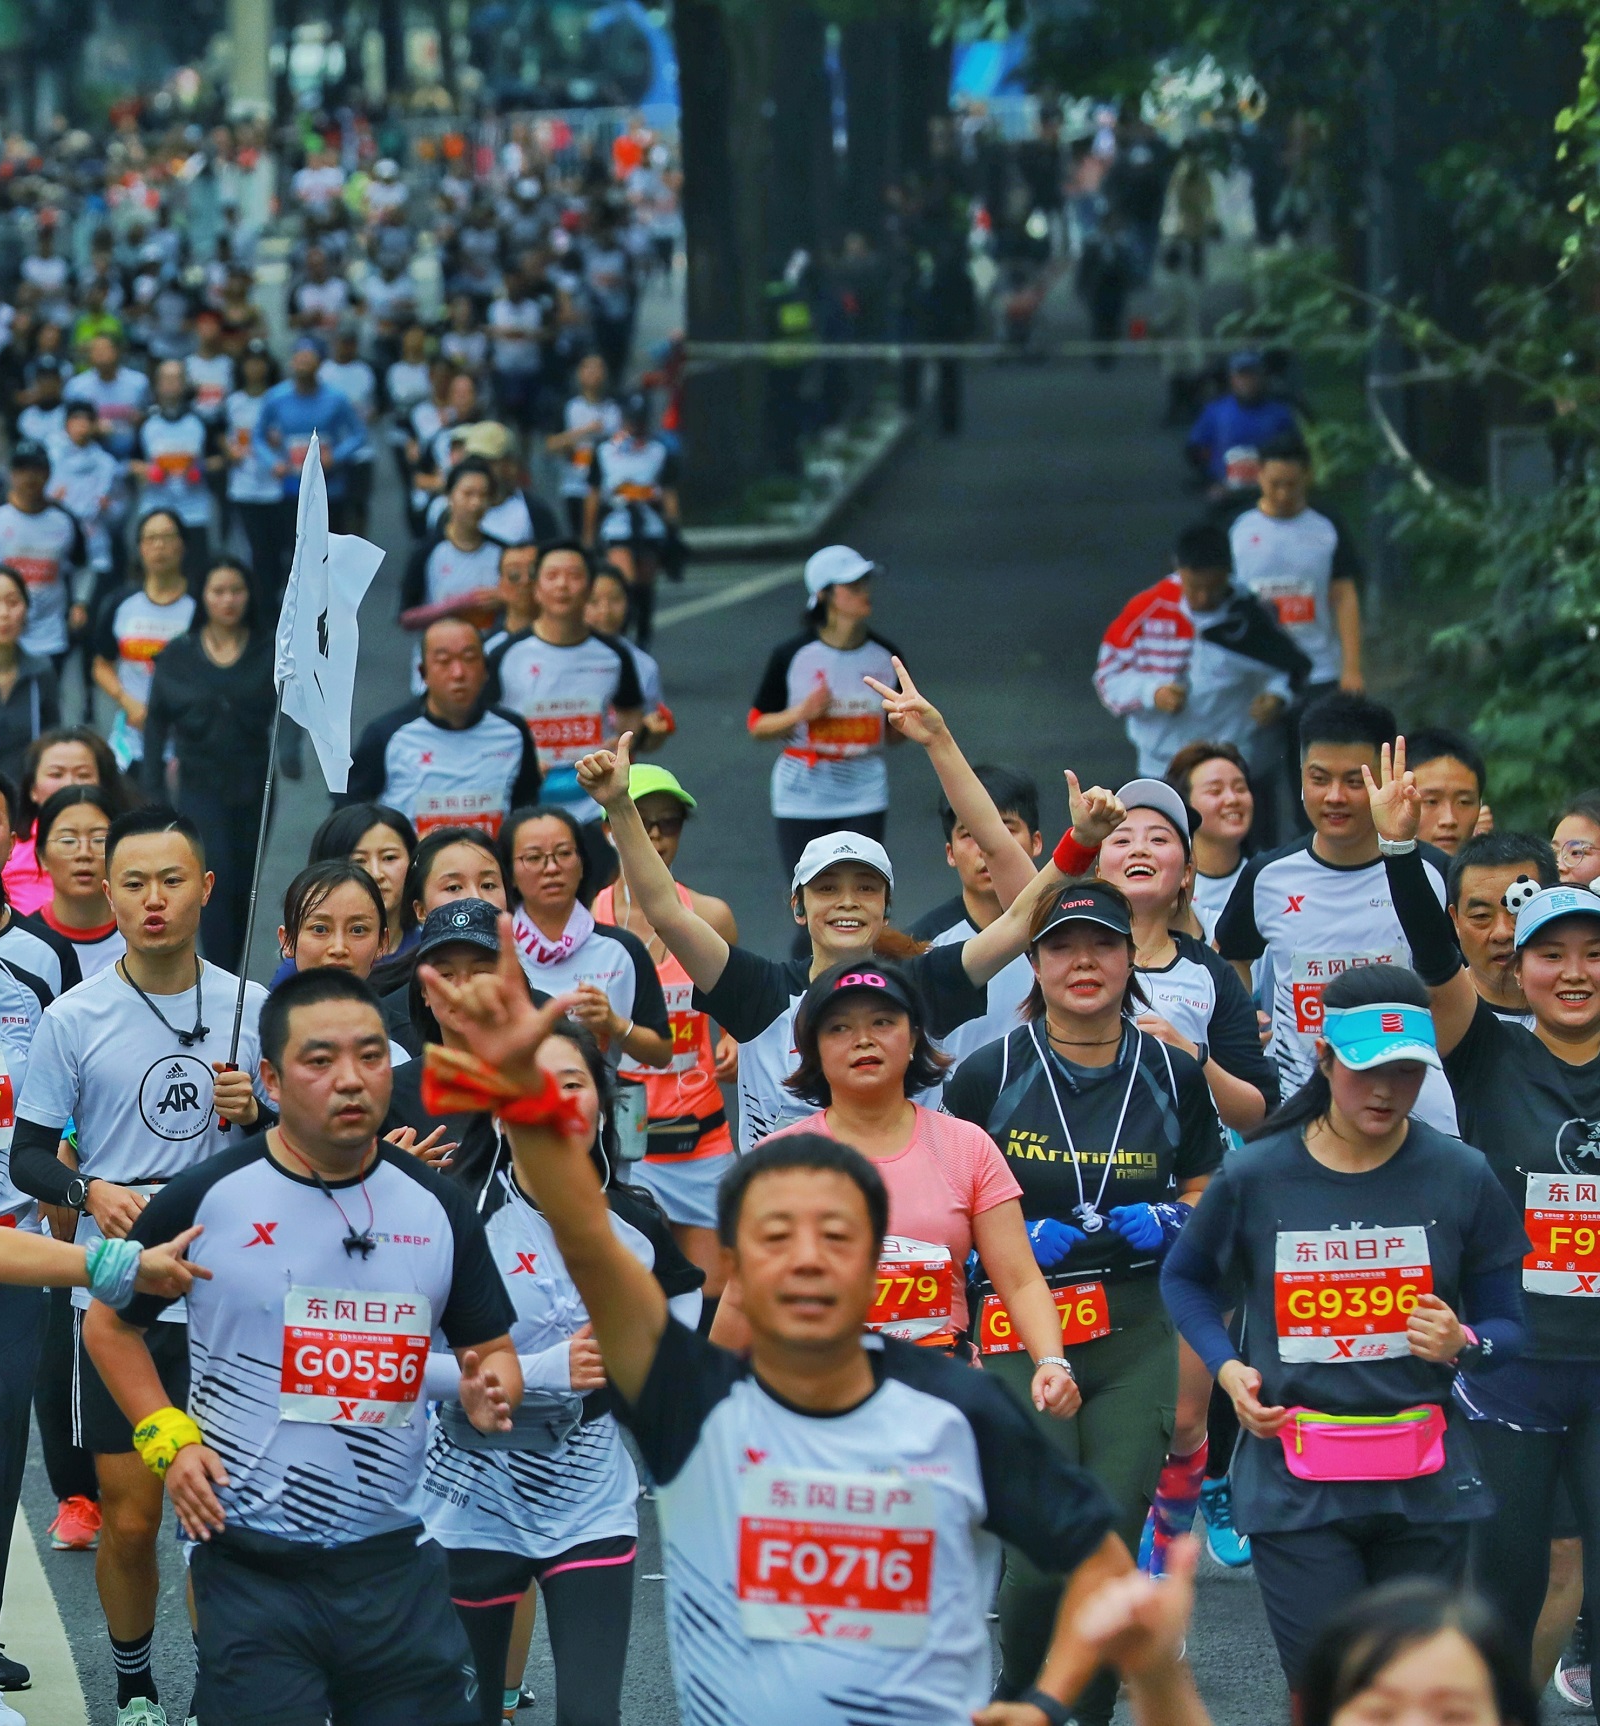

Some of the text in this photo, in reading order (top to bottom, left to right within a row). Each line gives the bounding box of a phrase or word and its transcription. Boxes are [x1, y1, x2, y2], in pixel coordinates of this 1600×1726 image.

[1061, 898, 1094, 911] vanke
[165, 1071, 188, 1080] adidas
[156, 1082, 201, 1114] AR
[1548, 1183, 1597, 1203] 东风
[1295, 1236, 1406, 1263] 东风日产
[1549, 1226, 1600, 1257] F9
[306, 1297, 417, 1325] 东风日产
[1287, 1284, 1419, 1320] G9396
[294, 1345, 419, 1385] G0556
[757, 1538, 914, 1593] F0716
